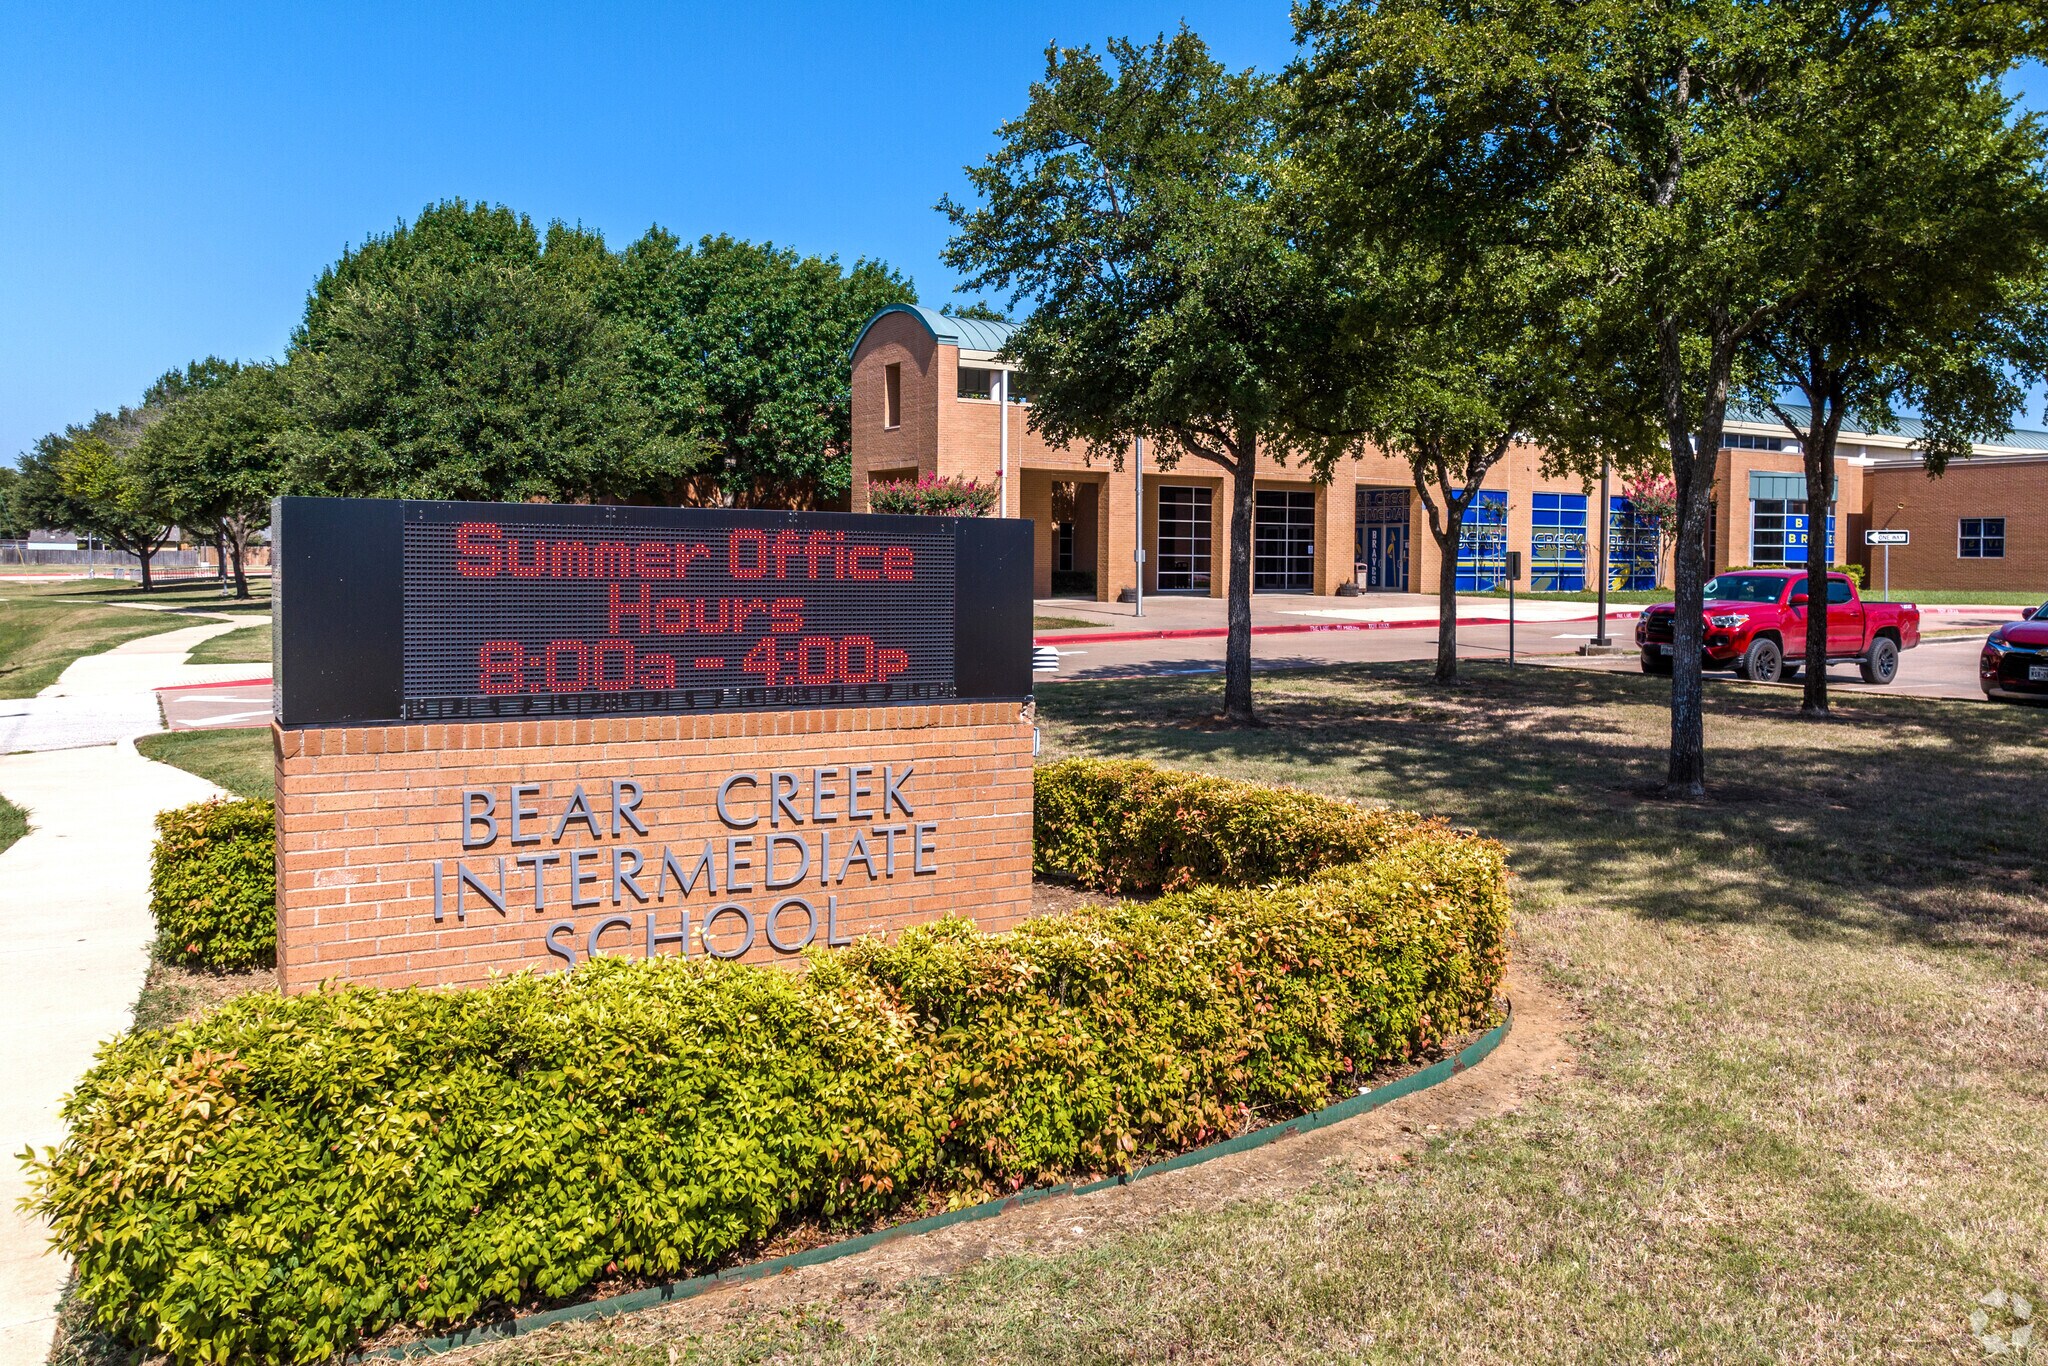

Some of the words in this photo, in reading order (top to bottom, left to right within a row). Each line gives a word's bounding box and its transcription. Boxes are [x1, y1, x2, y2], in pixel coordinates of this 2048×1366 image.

[457, 523, 712, 579] Summer
[729, 529, 914, 581] Office
[1534, 533, 1585, 551] CREEK
[609, 582, 805, 634] Hours
[480, 640, 676, 695] 8:00a
[694, 656, 725, 669] -
[743, 635, 910, 687] 4:00p
[462, 779, 649, 848] BEAR
[716, 765, 915, 829] CREEK
[433, 822, 939, 922] INTERMEDIATE
[545, 895, 852, 975] SCHOOL
